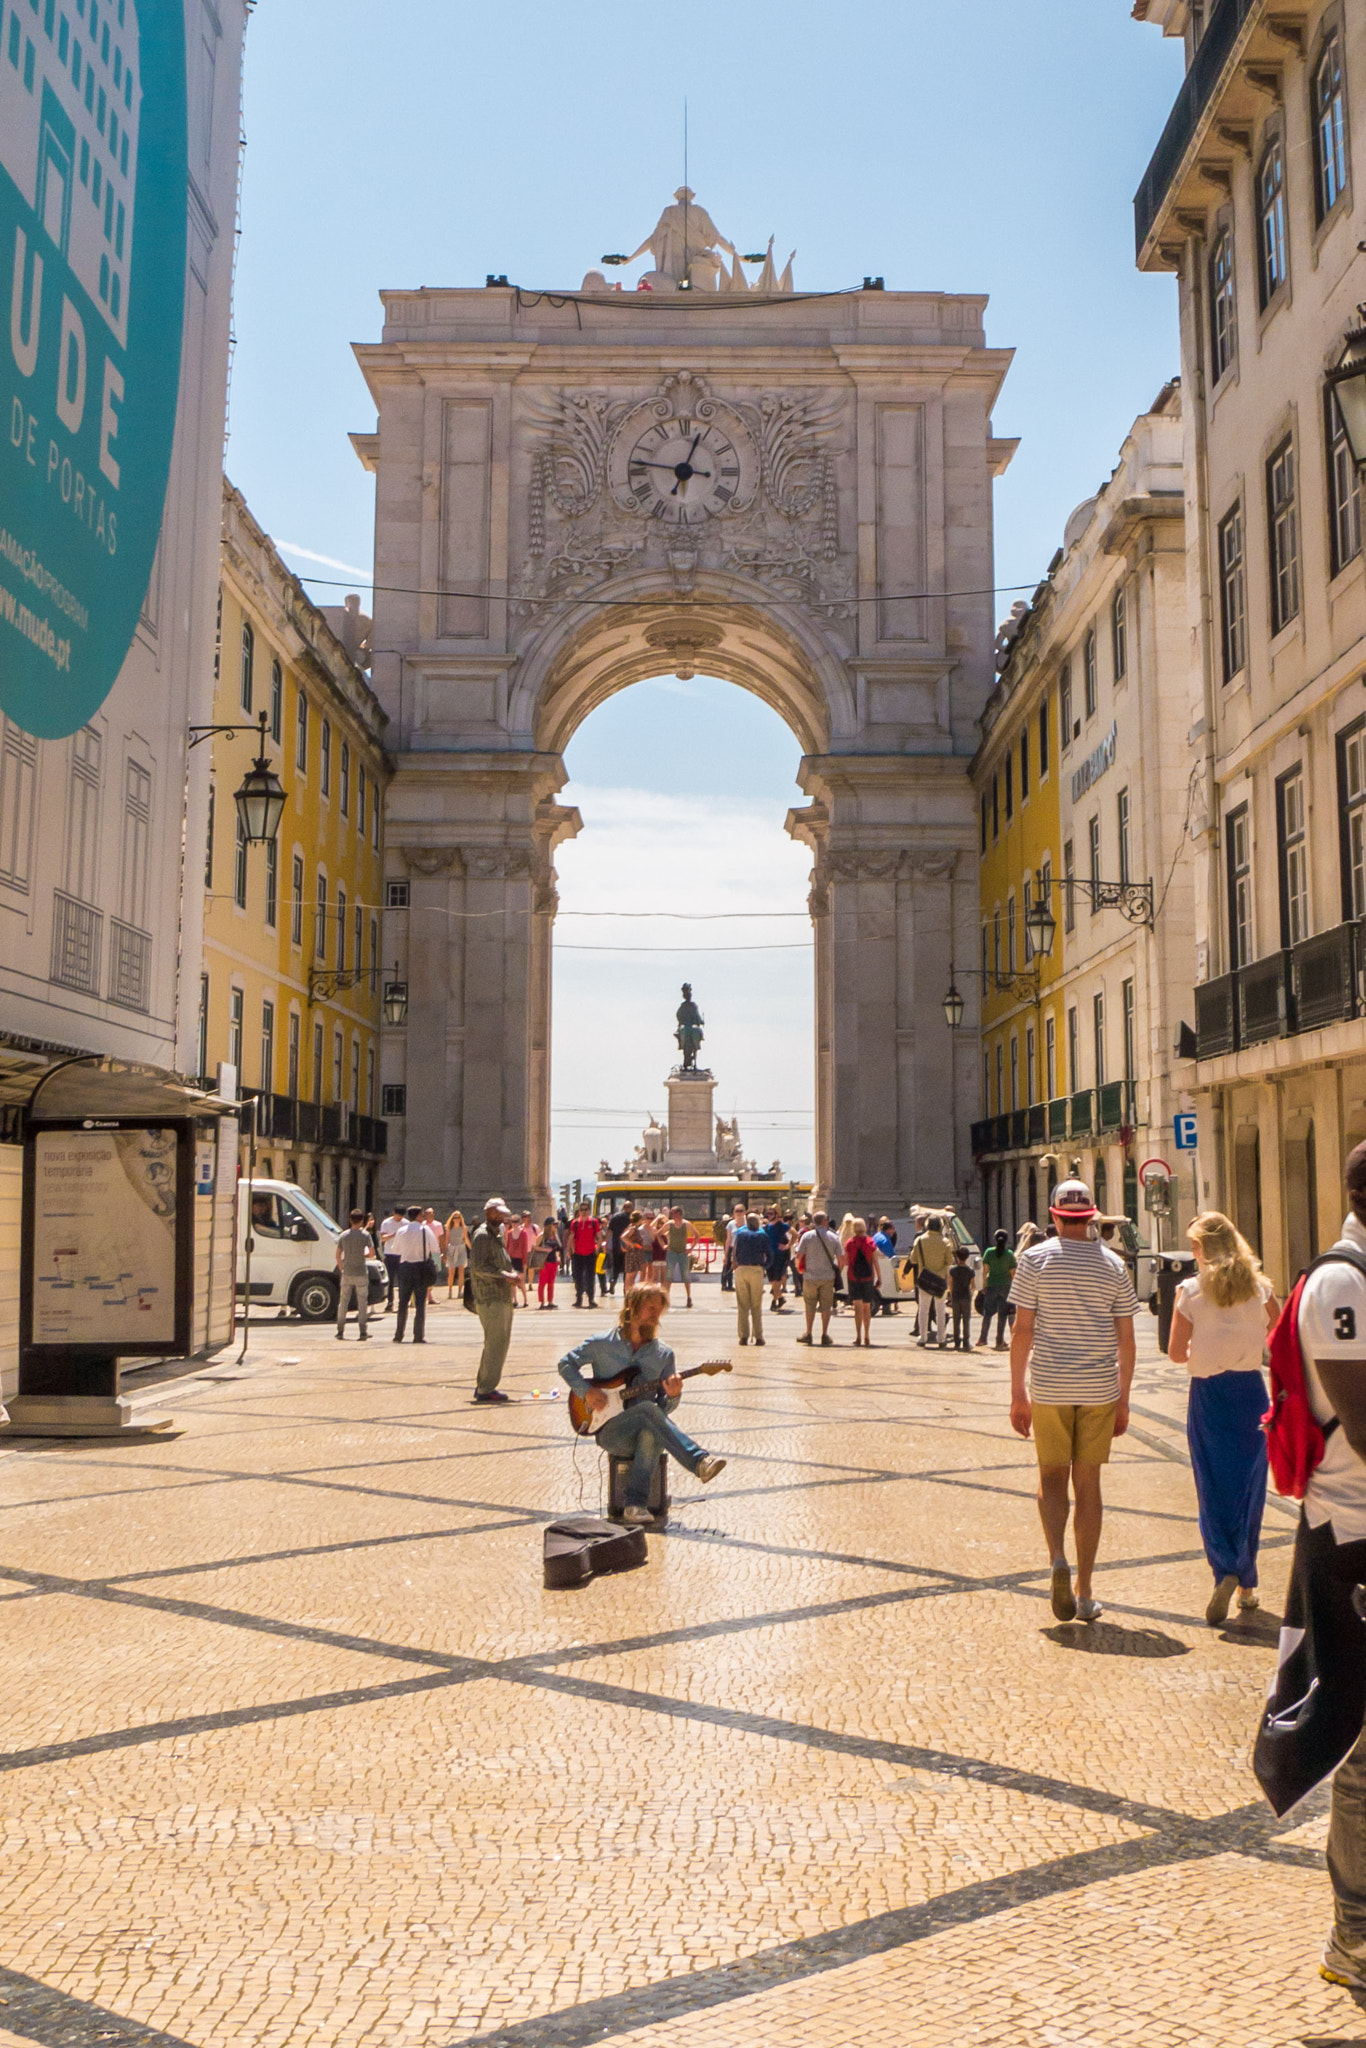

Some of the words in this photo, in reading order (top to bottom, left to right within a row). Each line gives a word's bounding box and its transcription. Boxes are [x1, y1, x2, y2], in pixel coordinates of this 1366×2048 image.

[10, 395, 38, 466] DE
[48, 439, 117, 555] PORTAS
[0, 585, 70, 672] w.mude.pt
[1180, 1117, 1197, 1146] P
[1333, 1306, 1356, 1341] 3
